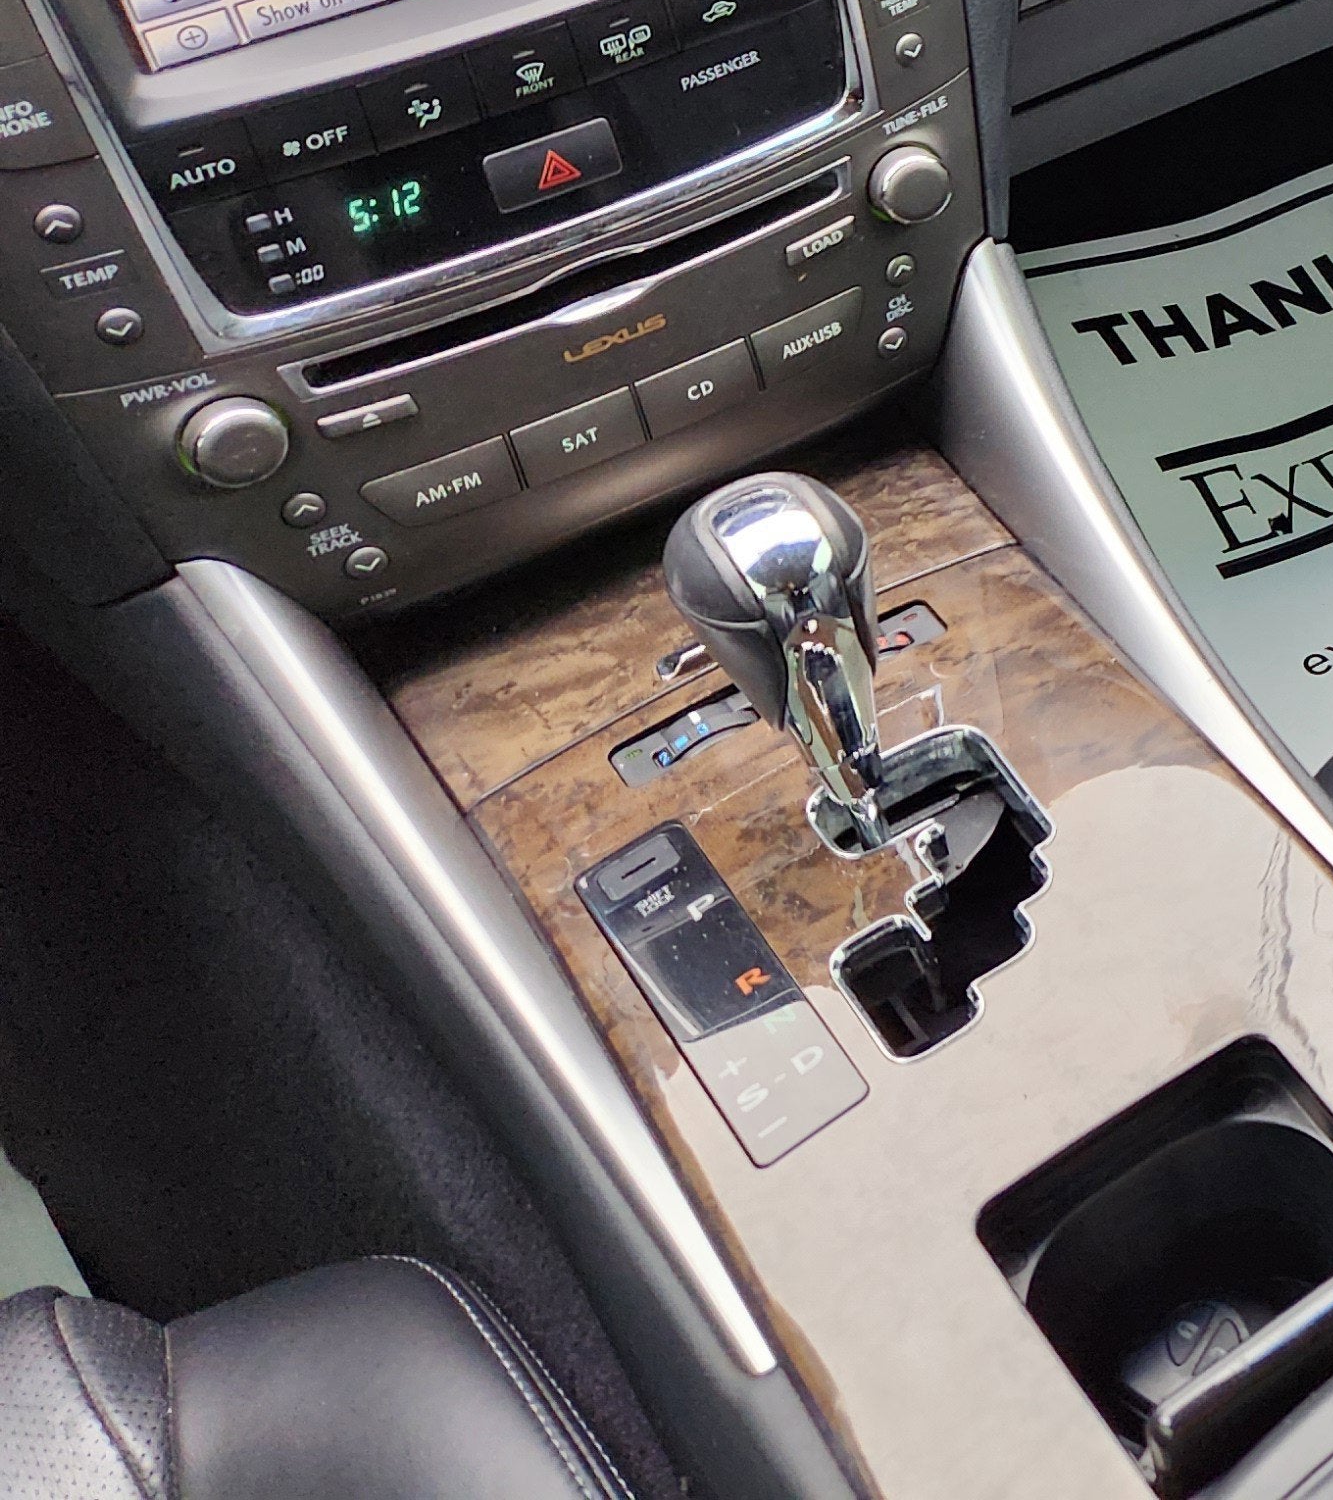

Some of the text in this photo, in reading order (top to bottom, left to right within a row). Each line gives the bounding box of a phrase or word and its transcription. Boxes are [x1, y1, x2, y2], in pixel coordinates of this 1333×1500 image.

[257, 2, 311, 27] Show
[614, 47, 645, 64] REAR
[680, 50, 761, 91] PASSENGER
[515, 76, 555, 98] FRONT
[305, 125, 349, 151] OFF
[169, 157, 237, 191] AUTO
[272, 207, 294, 226] H
[348, 180, 421, 233] 5:12
[285, 237, 307, 256] M
[802, 229, 845, 258] LOAD
[58, 263, 120, 290] TEMP
[296, 264, 325, 285] :00
[563, 313, 667, 363] LEXUS
[687, 379, 715, 401] CD
[560, 426, 599, 454] SAT
[306, 530, 364, 557] TRACK
[309, 522, 352, 545] SEEK
[686, 892, 716, 923] P
[734, 966, 772, 997] R
[789, 1045, 825, 1076] D
[736, 1081, 770, 1113] S
